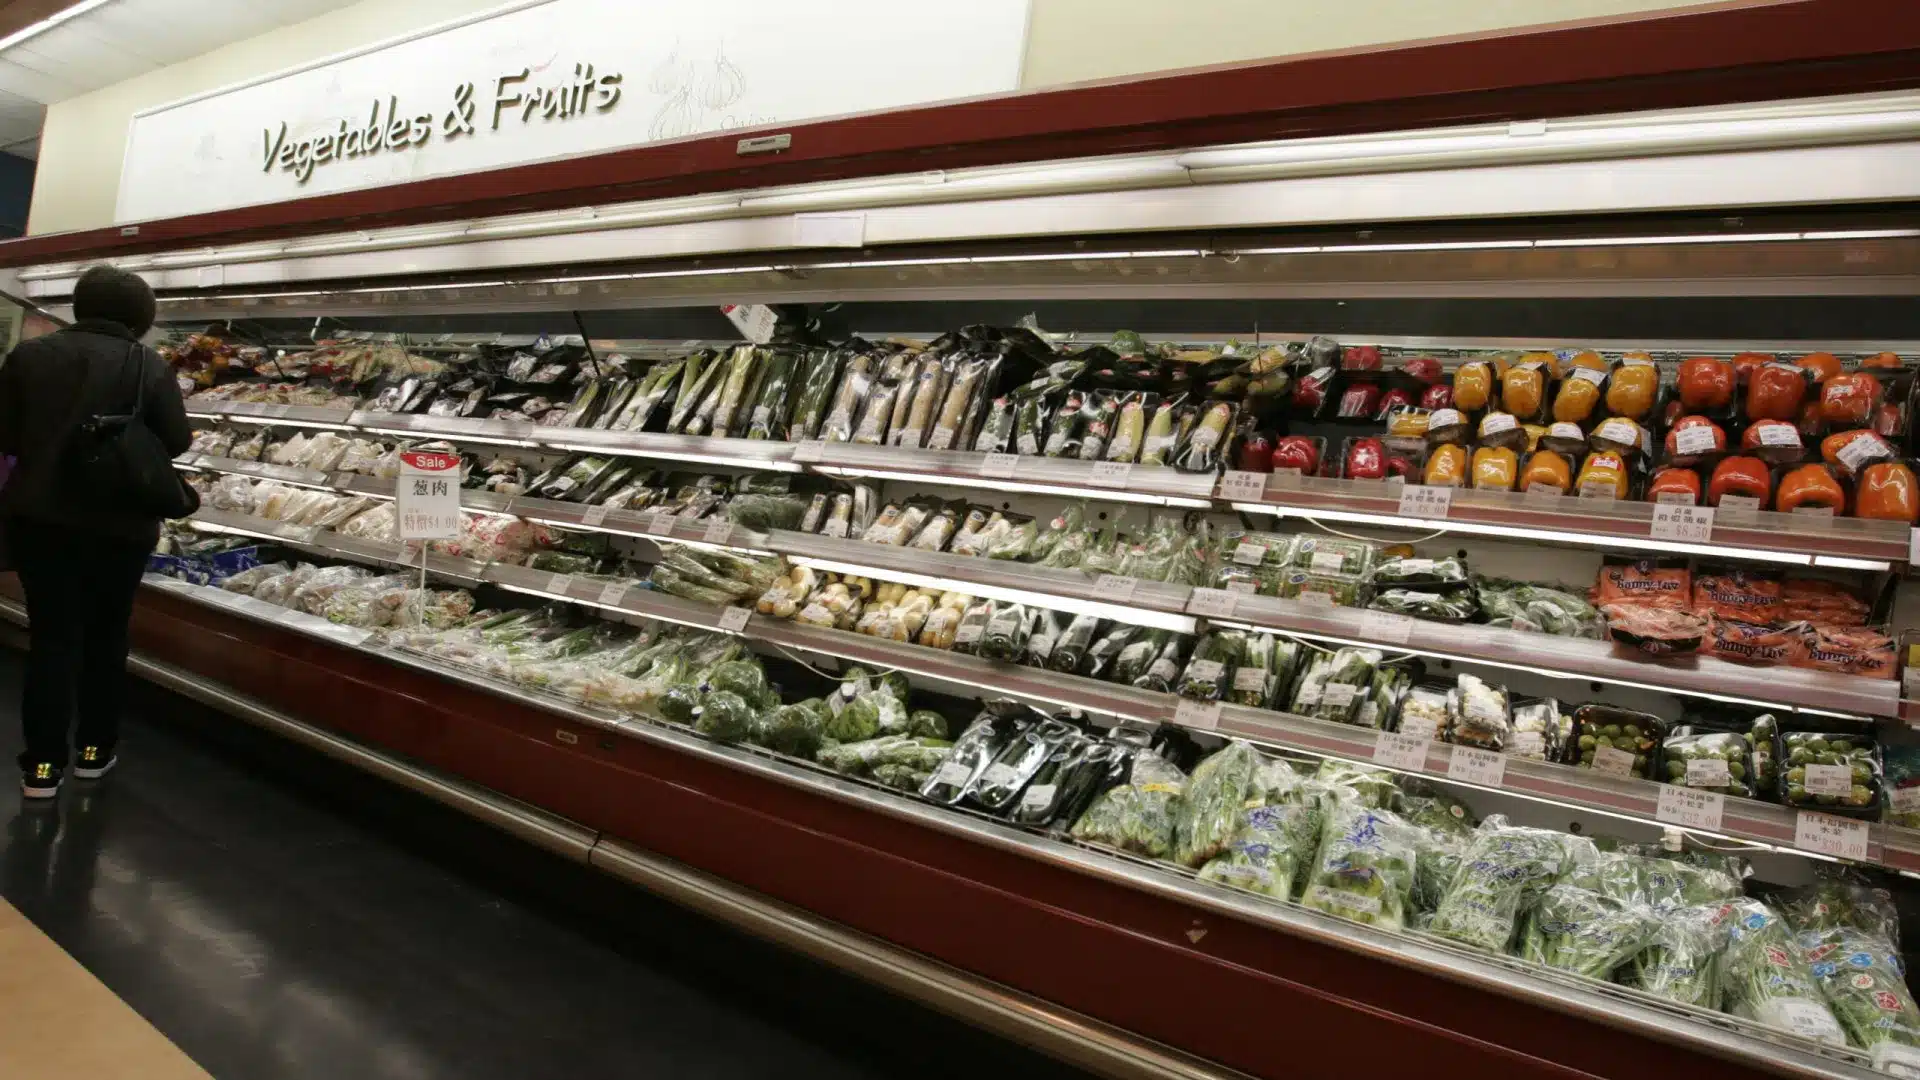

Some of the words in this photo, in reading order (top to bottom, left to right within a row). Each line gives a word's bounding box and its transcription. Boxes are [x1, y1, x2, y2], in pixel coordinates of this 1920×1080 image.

[258, 93, 433, 186] Vegetables
[443, 82, 475, 136] &
[491, 62, 624, 130] Fruits
[416, 456, 446, 468] Sale
